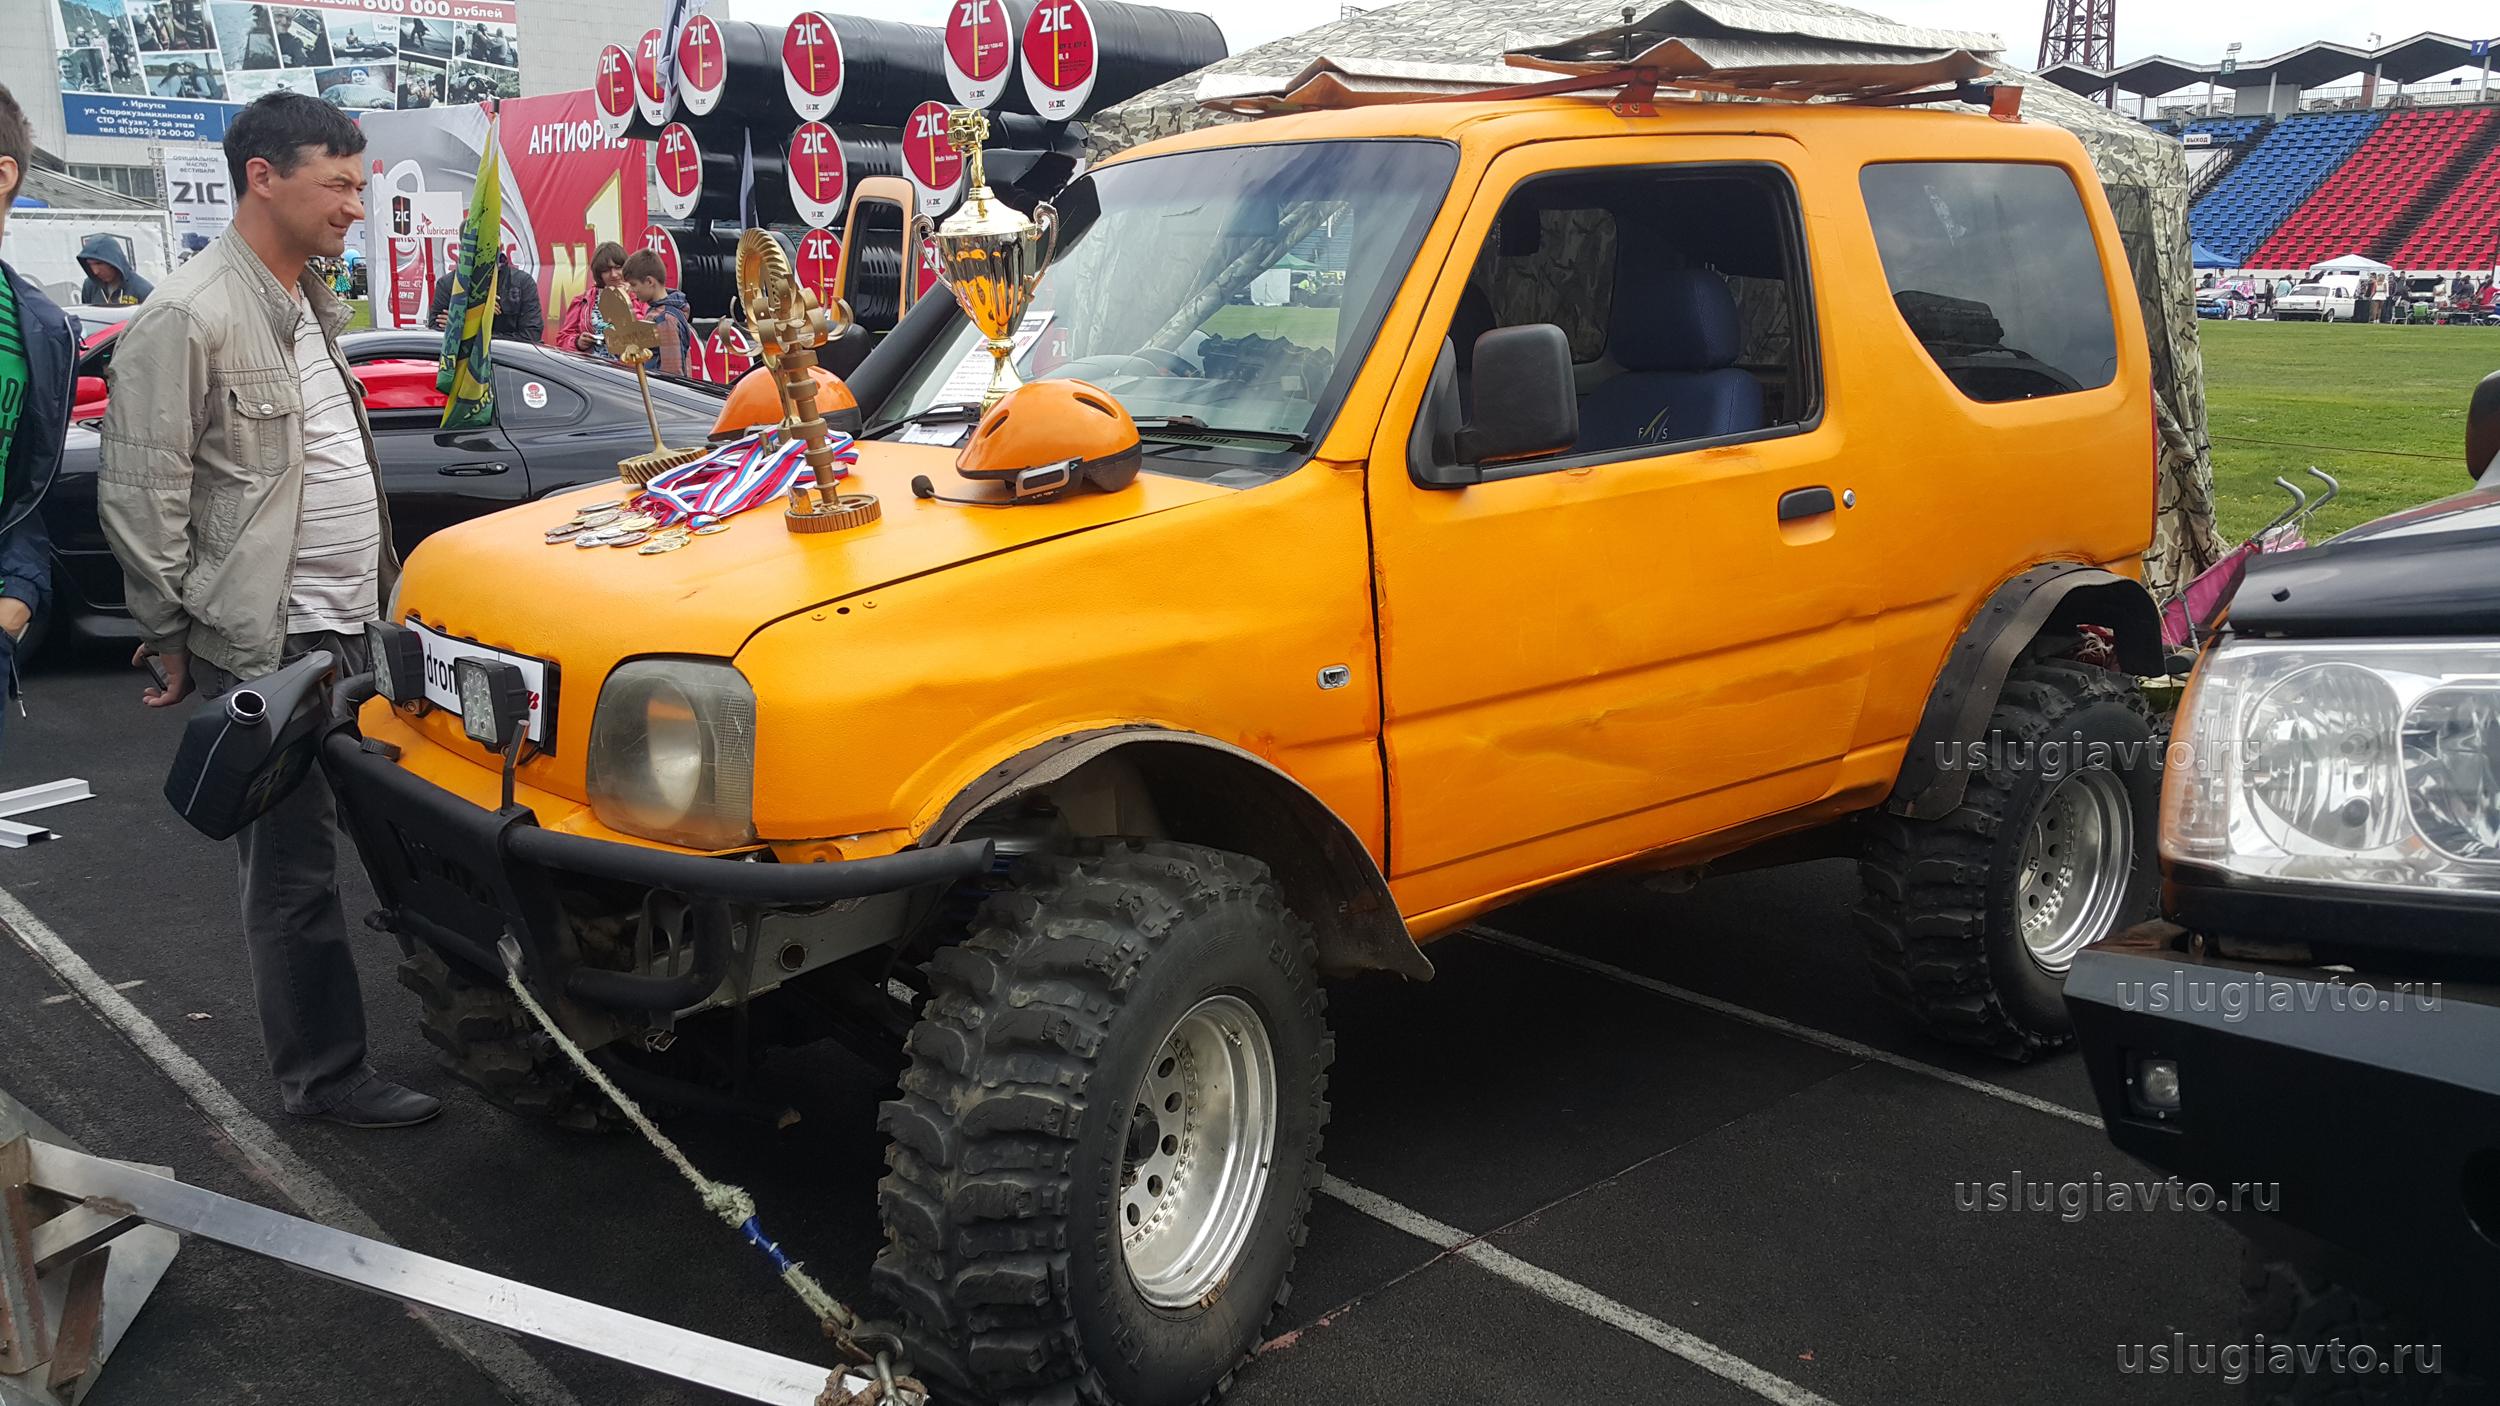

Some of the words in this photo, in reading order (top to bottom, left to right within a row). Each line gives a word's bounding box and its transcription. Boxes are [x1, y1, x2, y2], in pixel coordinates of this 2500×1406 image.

[454, 6, 503, 18] рублей
[960, 0, 991, 28] ZIC
[1038, 4, 1072, 34] ZIC
[688, 24, 711, 46] ZIC
[794, 23, 824, 46] ZIC
[2476, 42, 2483, 53] 7
[602, 54, 621, 74] ZIC
[2224, 62, 2232, 73] 6
[130, 100, 166, 110] Иркутск
[152, 120, 172, 128] 2-ой
[194, 112, 205, 120] 62
[916, 112, 945, 138] ZIC
[664, 131, 686, 154] ZIC
[801, 132, 828, 154] ZIC
[171, 181, 228, 205] ZIC
[416, 225, 425, 235] SK
[427, 226, 458, 236] lubricants
[646, 234, 666, 254] ZIC
[808, 240, 834, 260] ZIC
